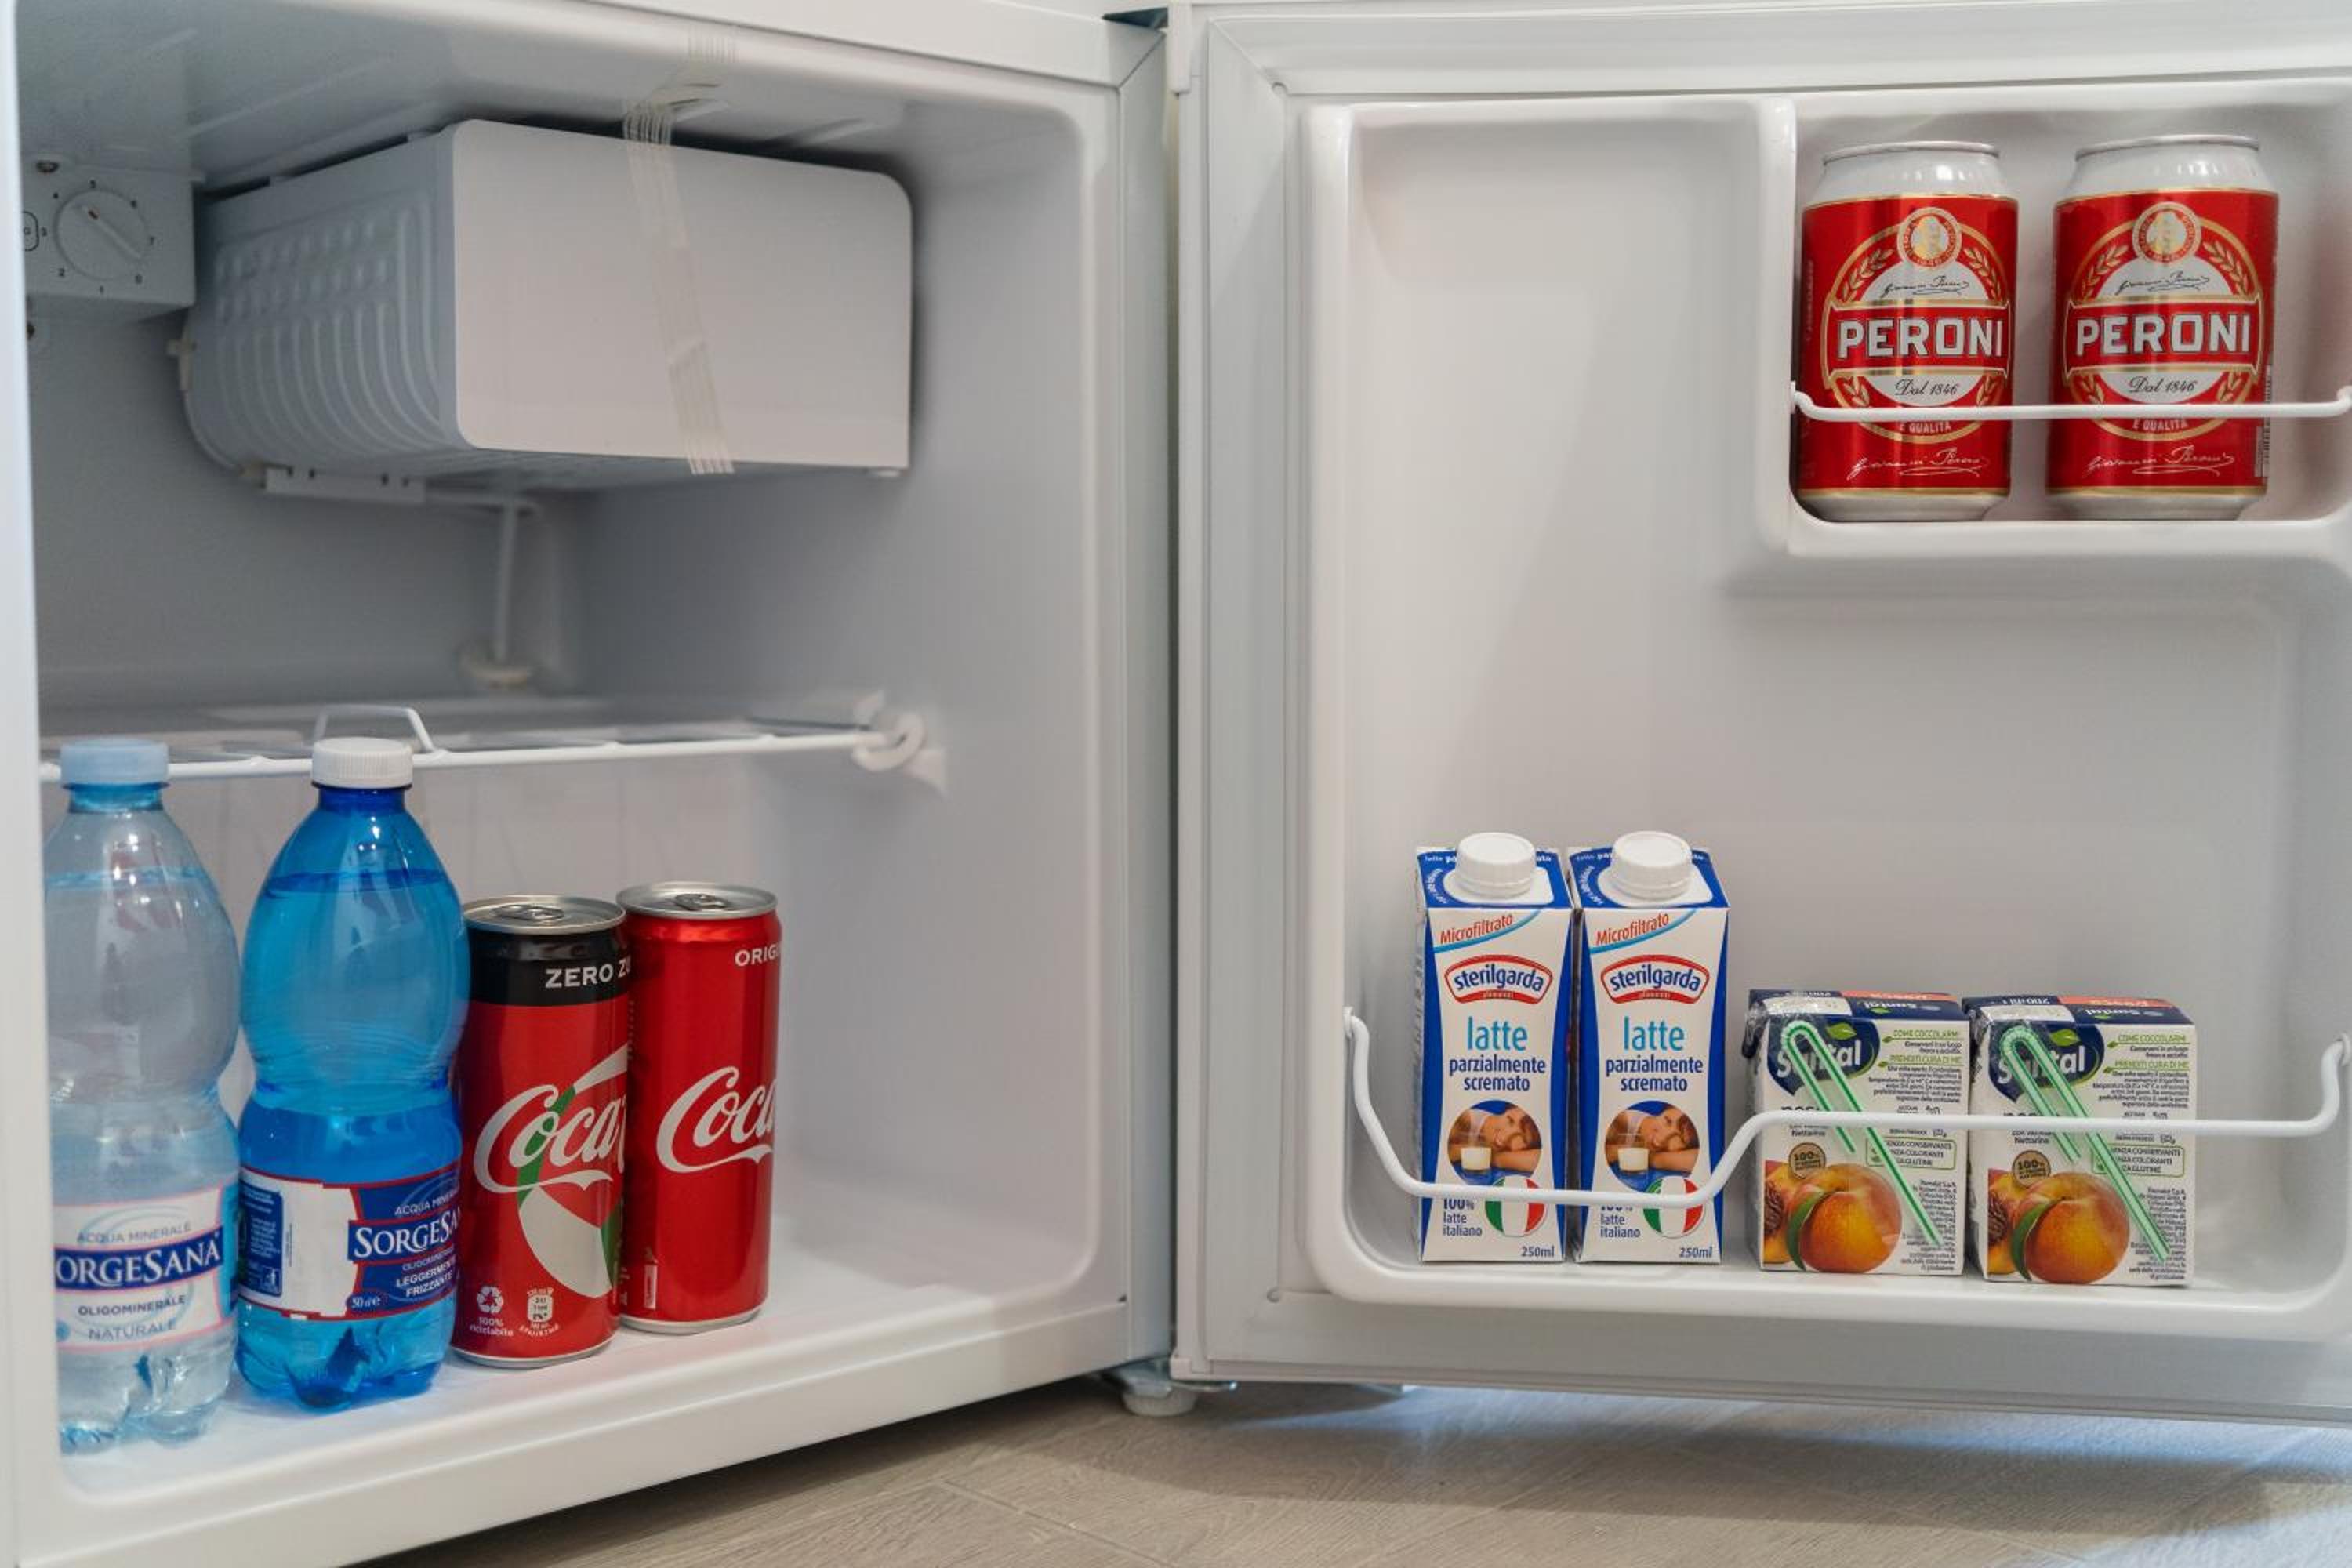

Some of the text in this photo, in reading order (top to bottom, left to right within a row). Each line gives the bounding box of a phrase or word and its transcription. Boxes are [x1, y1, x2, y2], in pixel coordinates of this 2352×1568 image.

[1837, 317, 2003, 359] PERONI
[2074, 313, 2251, 357] PERONI
[1894, 378, 1960, 396] Dal 1846
[2128, 376, 2198, 394] Dal 1846
[1440, 914, 1514, 945] Microfiltrato
[1595, 913, 1670, 946] Microfiltrato
[545, 963, 614, 989] ZERO
[1454, 964, 1544, 992] sterilgarda
[1610, 964, 1702, 992] sterilgarda
[1467, 1016, 1528, 1051] latte
[1623, 1016, 1685, 1051] latte
[1448, 1054, 1546, 1077] parzialmente
[1605, 1054, 1704, 1078] parzialmente
[1463, 1076, 1531, 1092] scremato
[1621, 1076, 1688, 1092] scremato
[656, 1065, 776, 1174] Coca
[394, 1200, 430, 1217] ACQUA
[1443, 1211, 1467, 1224] latte
[1600, 1214, 1626, 1225] latte
[76, 1221, 191, 1244] ACQUA MINERALE
[1443, 1225, 1483, 1237] italiano
[1600, 1226, 1641, 1238] italiano
[1521, 1245, 1555, 1258] 250ml
[1679, 1246, 1713, 1258] 250ml
[55, 1240, 220, 1287] ORGESANA
[78, 1294, 186, 1316] OLIGOMINERALE
[88, 1316, 177, 1341] NATURALE
